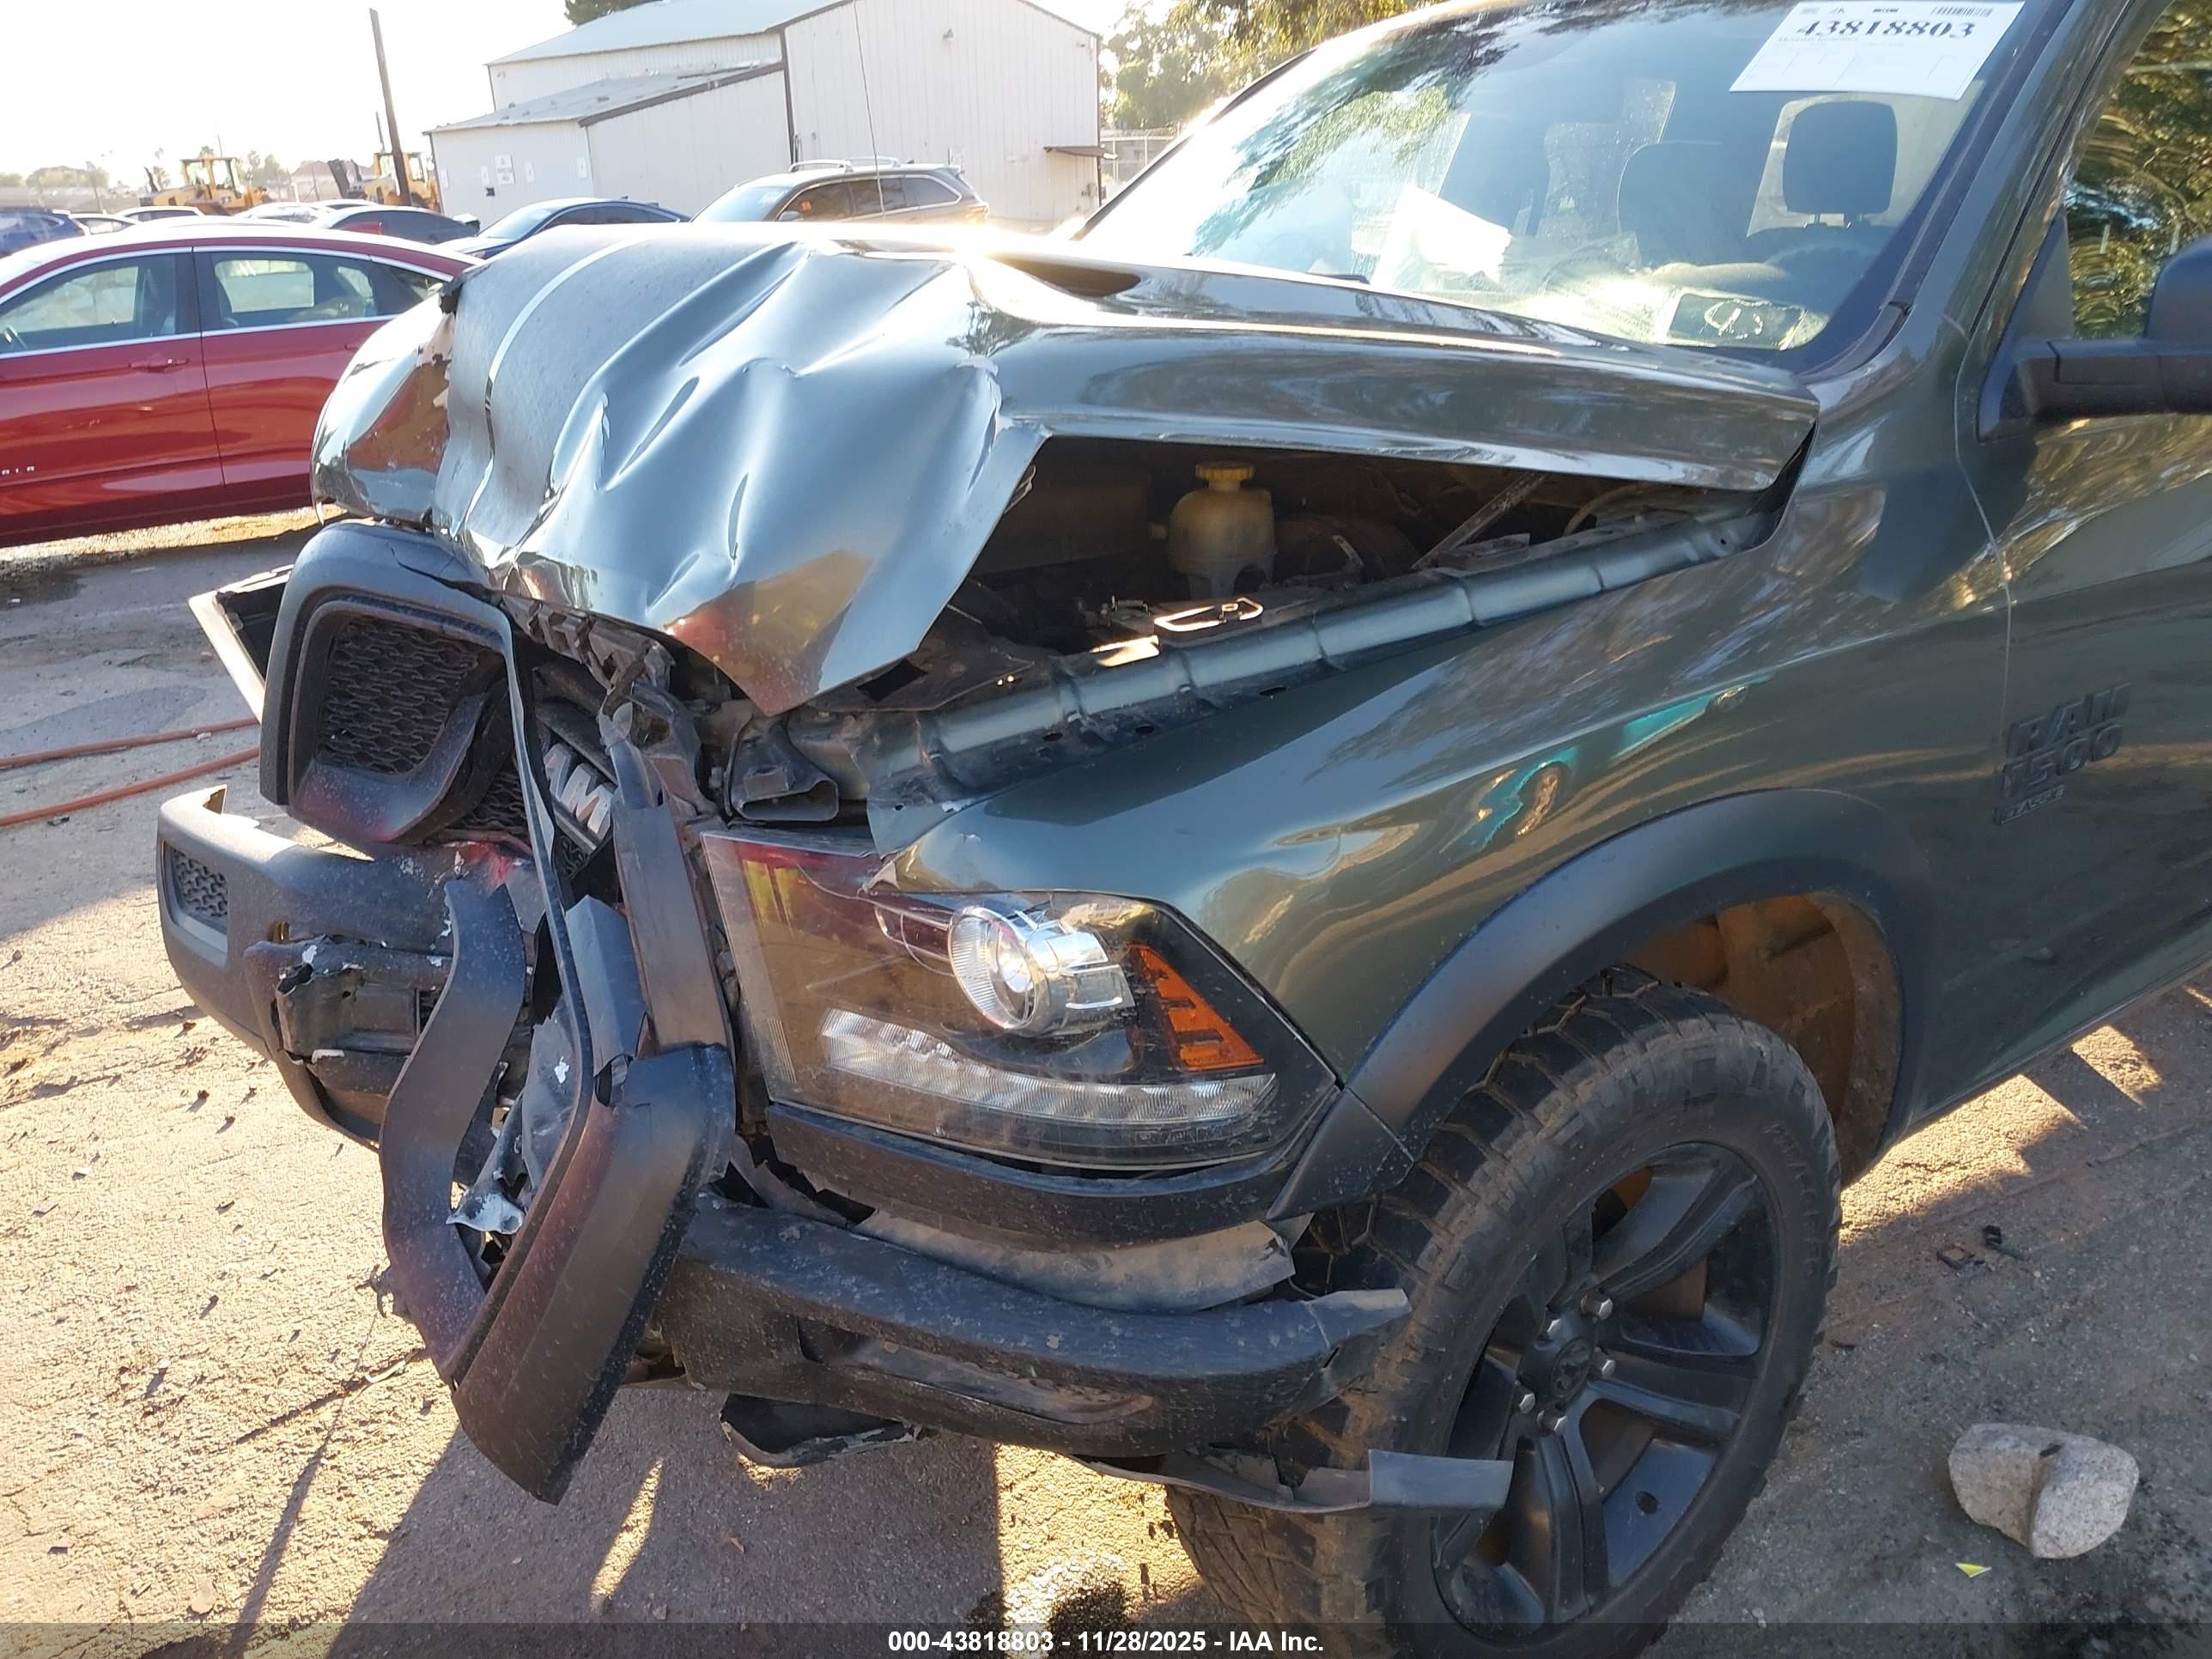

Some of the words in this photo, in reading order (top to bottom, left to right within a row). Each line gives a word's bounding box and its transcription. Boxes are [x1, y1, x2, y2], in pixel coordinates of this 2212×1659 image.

[1795, 20, 1977, 39] 43818803
[2006, 682, 2130, 761] RAM
[2000, 724, 2123, 798] 1500
